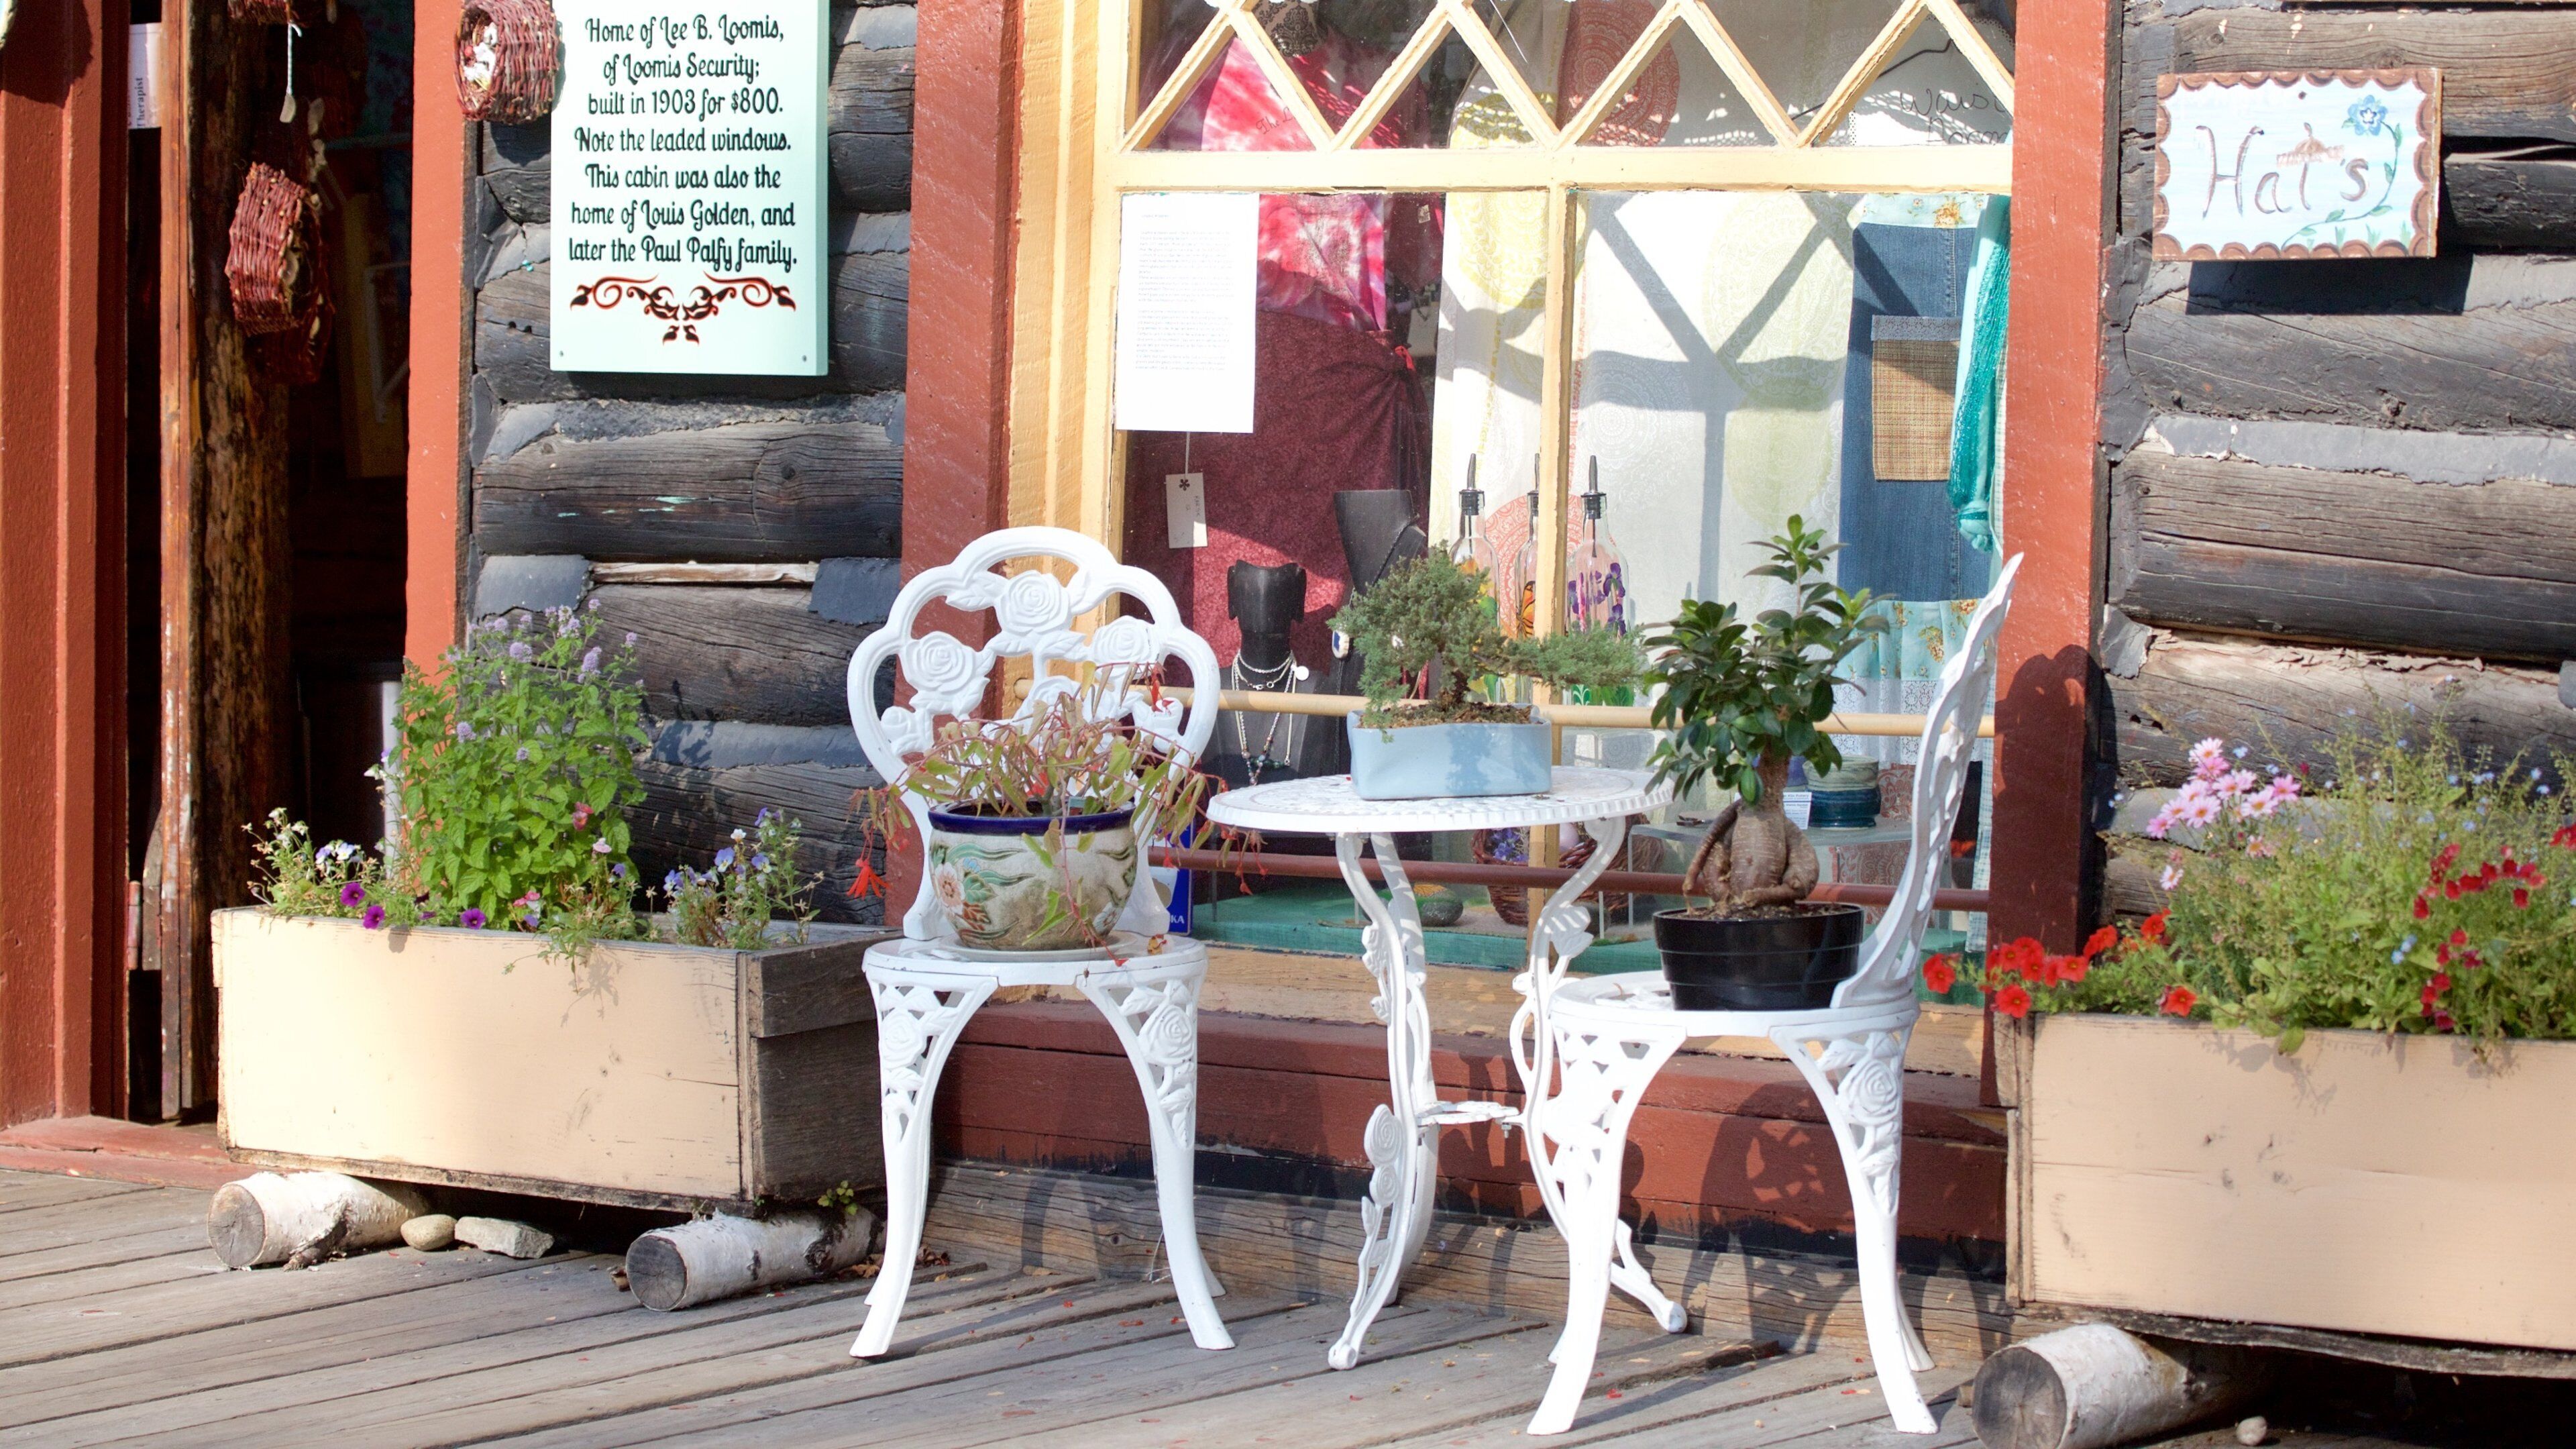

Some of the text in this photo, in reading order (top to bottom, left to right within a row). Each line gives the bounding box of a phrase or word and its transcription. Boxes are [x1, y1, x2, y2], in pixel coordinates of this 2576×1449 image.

[585, 13, 784, 49] Home of Lee B. Loomis,
[604, 52, 759, 87] of Loomis Security;
[134, 77, 147, 129] Therapist
[588, 87, 783, 122] built in 1903 for $800.
[574, 127, 792, 152] Note the leaded windows.
[1255, 115, 1281, 135] The
[585, 163, 781, 189] This cabin was also the
[572, 199, 796, 234] home of Louis Golden, and
[569, 235, 797, 274] later the Paul Palfy family.
